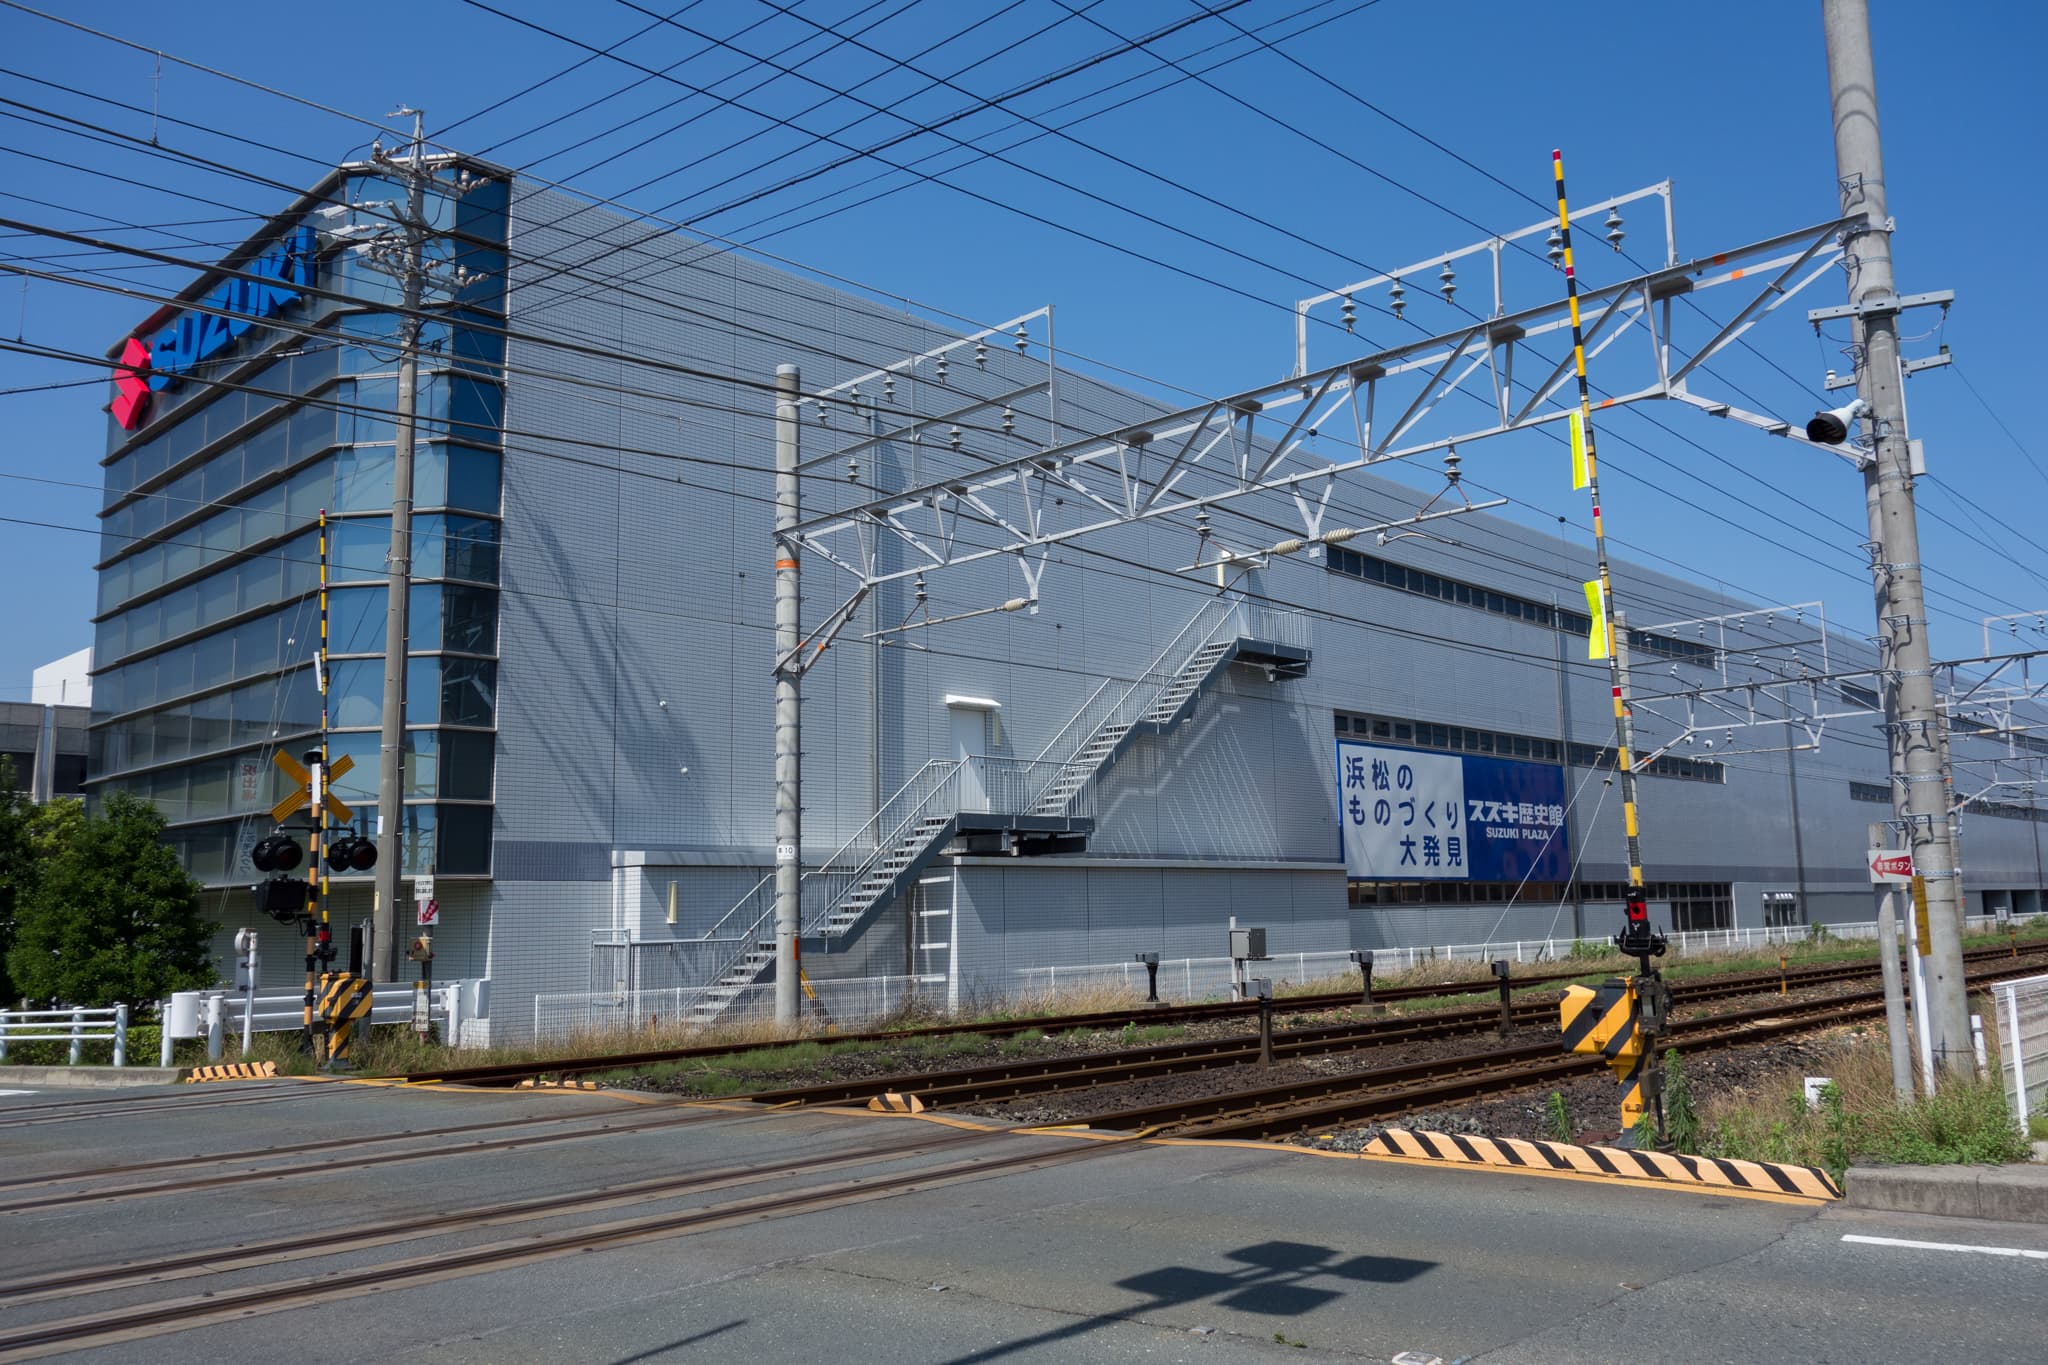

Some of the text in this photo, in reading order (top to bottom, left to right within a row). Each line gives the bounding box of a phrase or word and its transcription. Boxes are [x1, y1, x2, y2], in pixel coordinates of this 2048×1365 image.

[149, 225, 317, 392] SUZUKI
[1346, 756, 1413, 791] 浜松の
[1349, 795, 1458, 829] ものづくり
[1469, 800, 1563, 826] スズキ歴史館
[1486, 827, 1549, 840] SUZUKI PLAZA
[1400, 834, 1462, 867] 大発見
